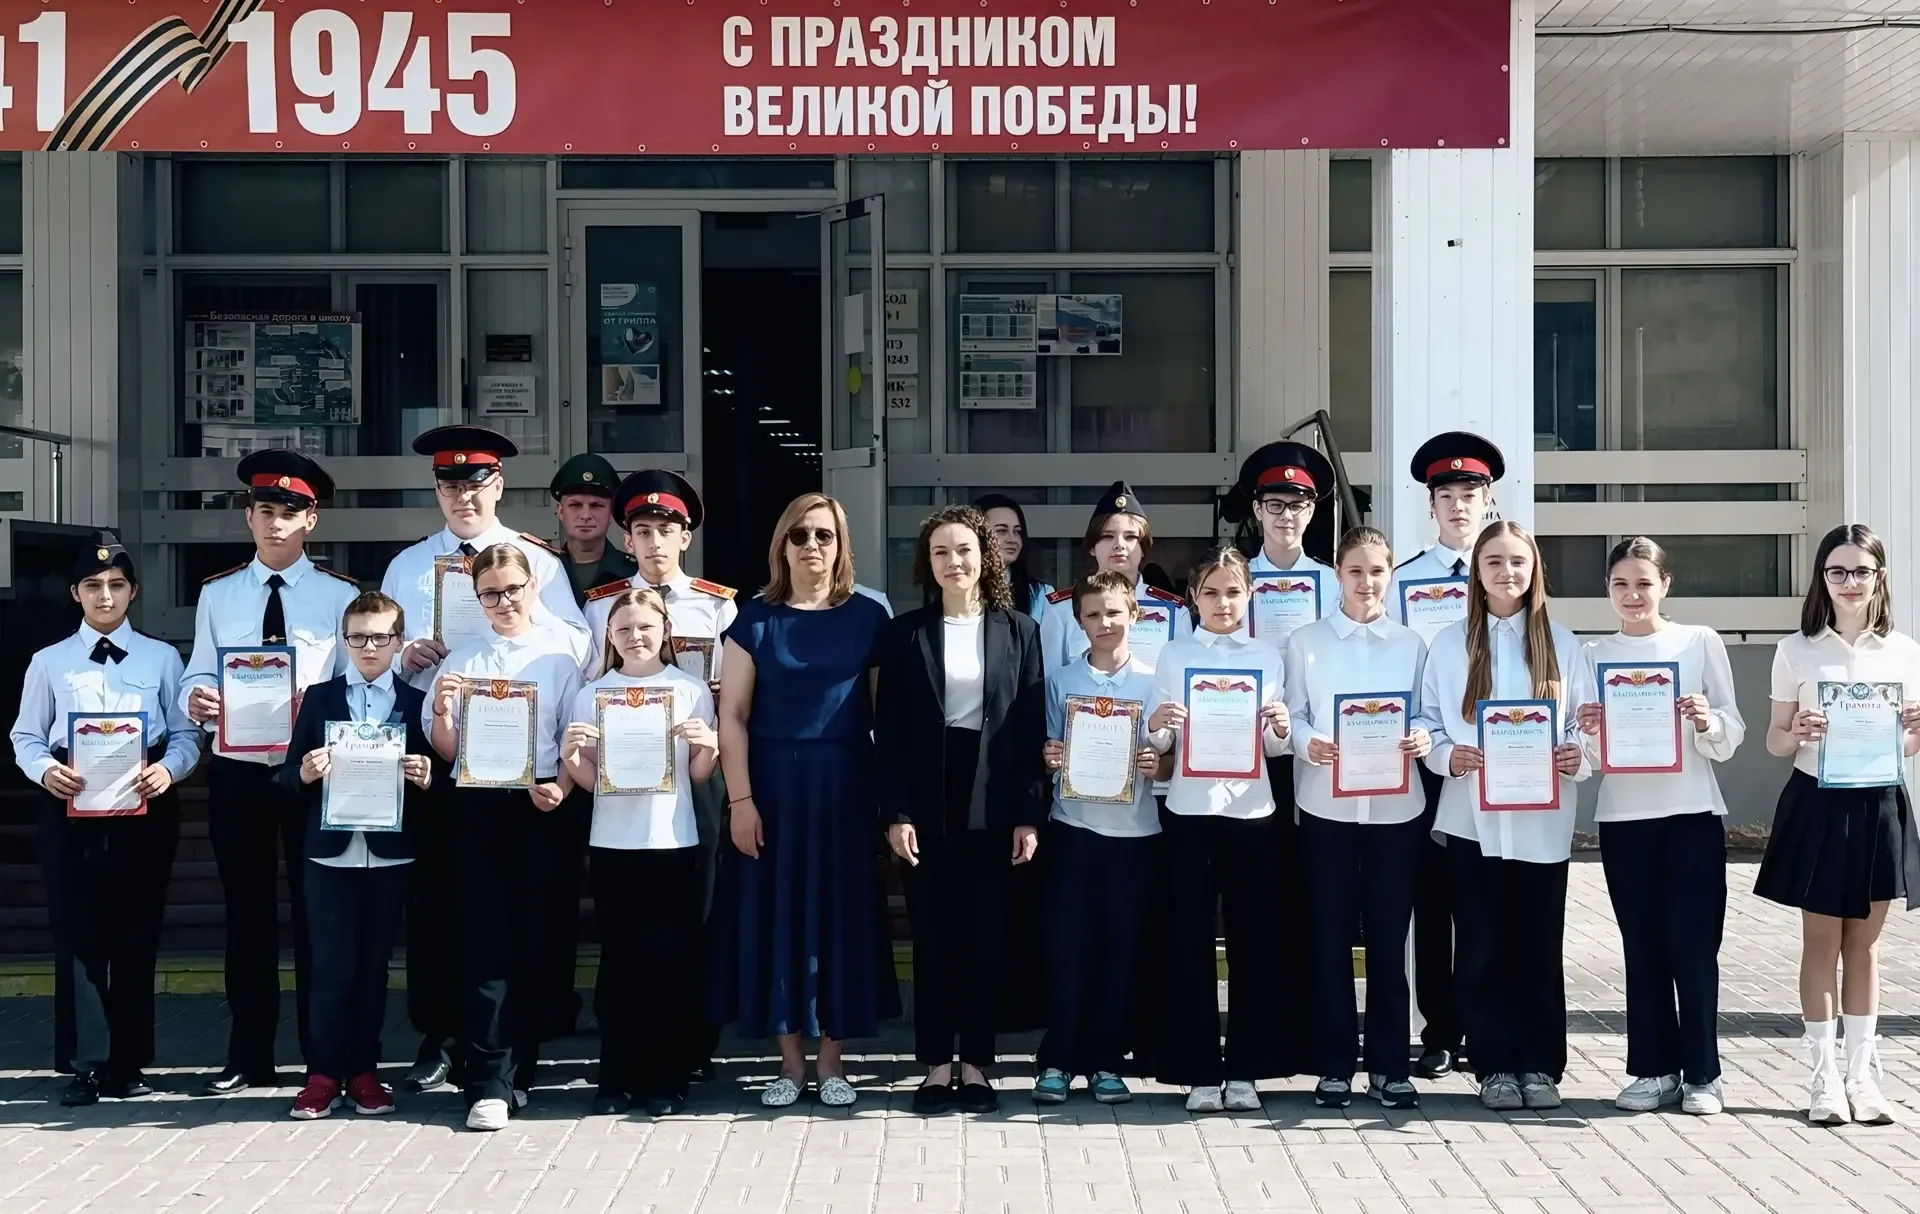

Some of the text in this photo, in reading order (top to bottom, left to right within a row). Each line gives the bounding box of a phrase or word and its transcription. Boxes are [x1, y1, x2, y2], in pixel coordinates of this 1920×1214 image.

[723, 16, 1115, 76] С ПРАЗДНИКОМ
[0, 8, 517, 136] 1 1945
[723, 80, 1197, 142] ВЕЛИКОЙ ПОБЕДЫ!
[210, 311, 270, 321] Безопасная
[271, 314, 308, 322] дорога
[318, 314, 351, 324] школу
[603, 317, 657, 325] ОТ ГРИППА
[887, 381, 905, 391] ИК
[1840, 701, 1881, 711] Грамота
[1081, 721, 1124, 733] ГРАМОТА
